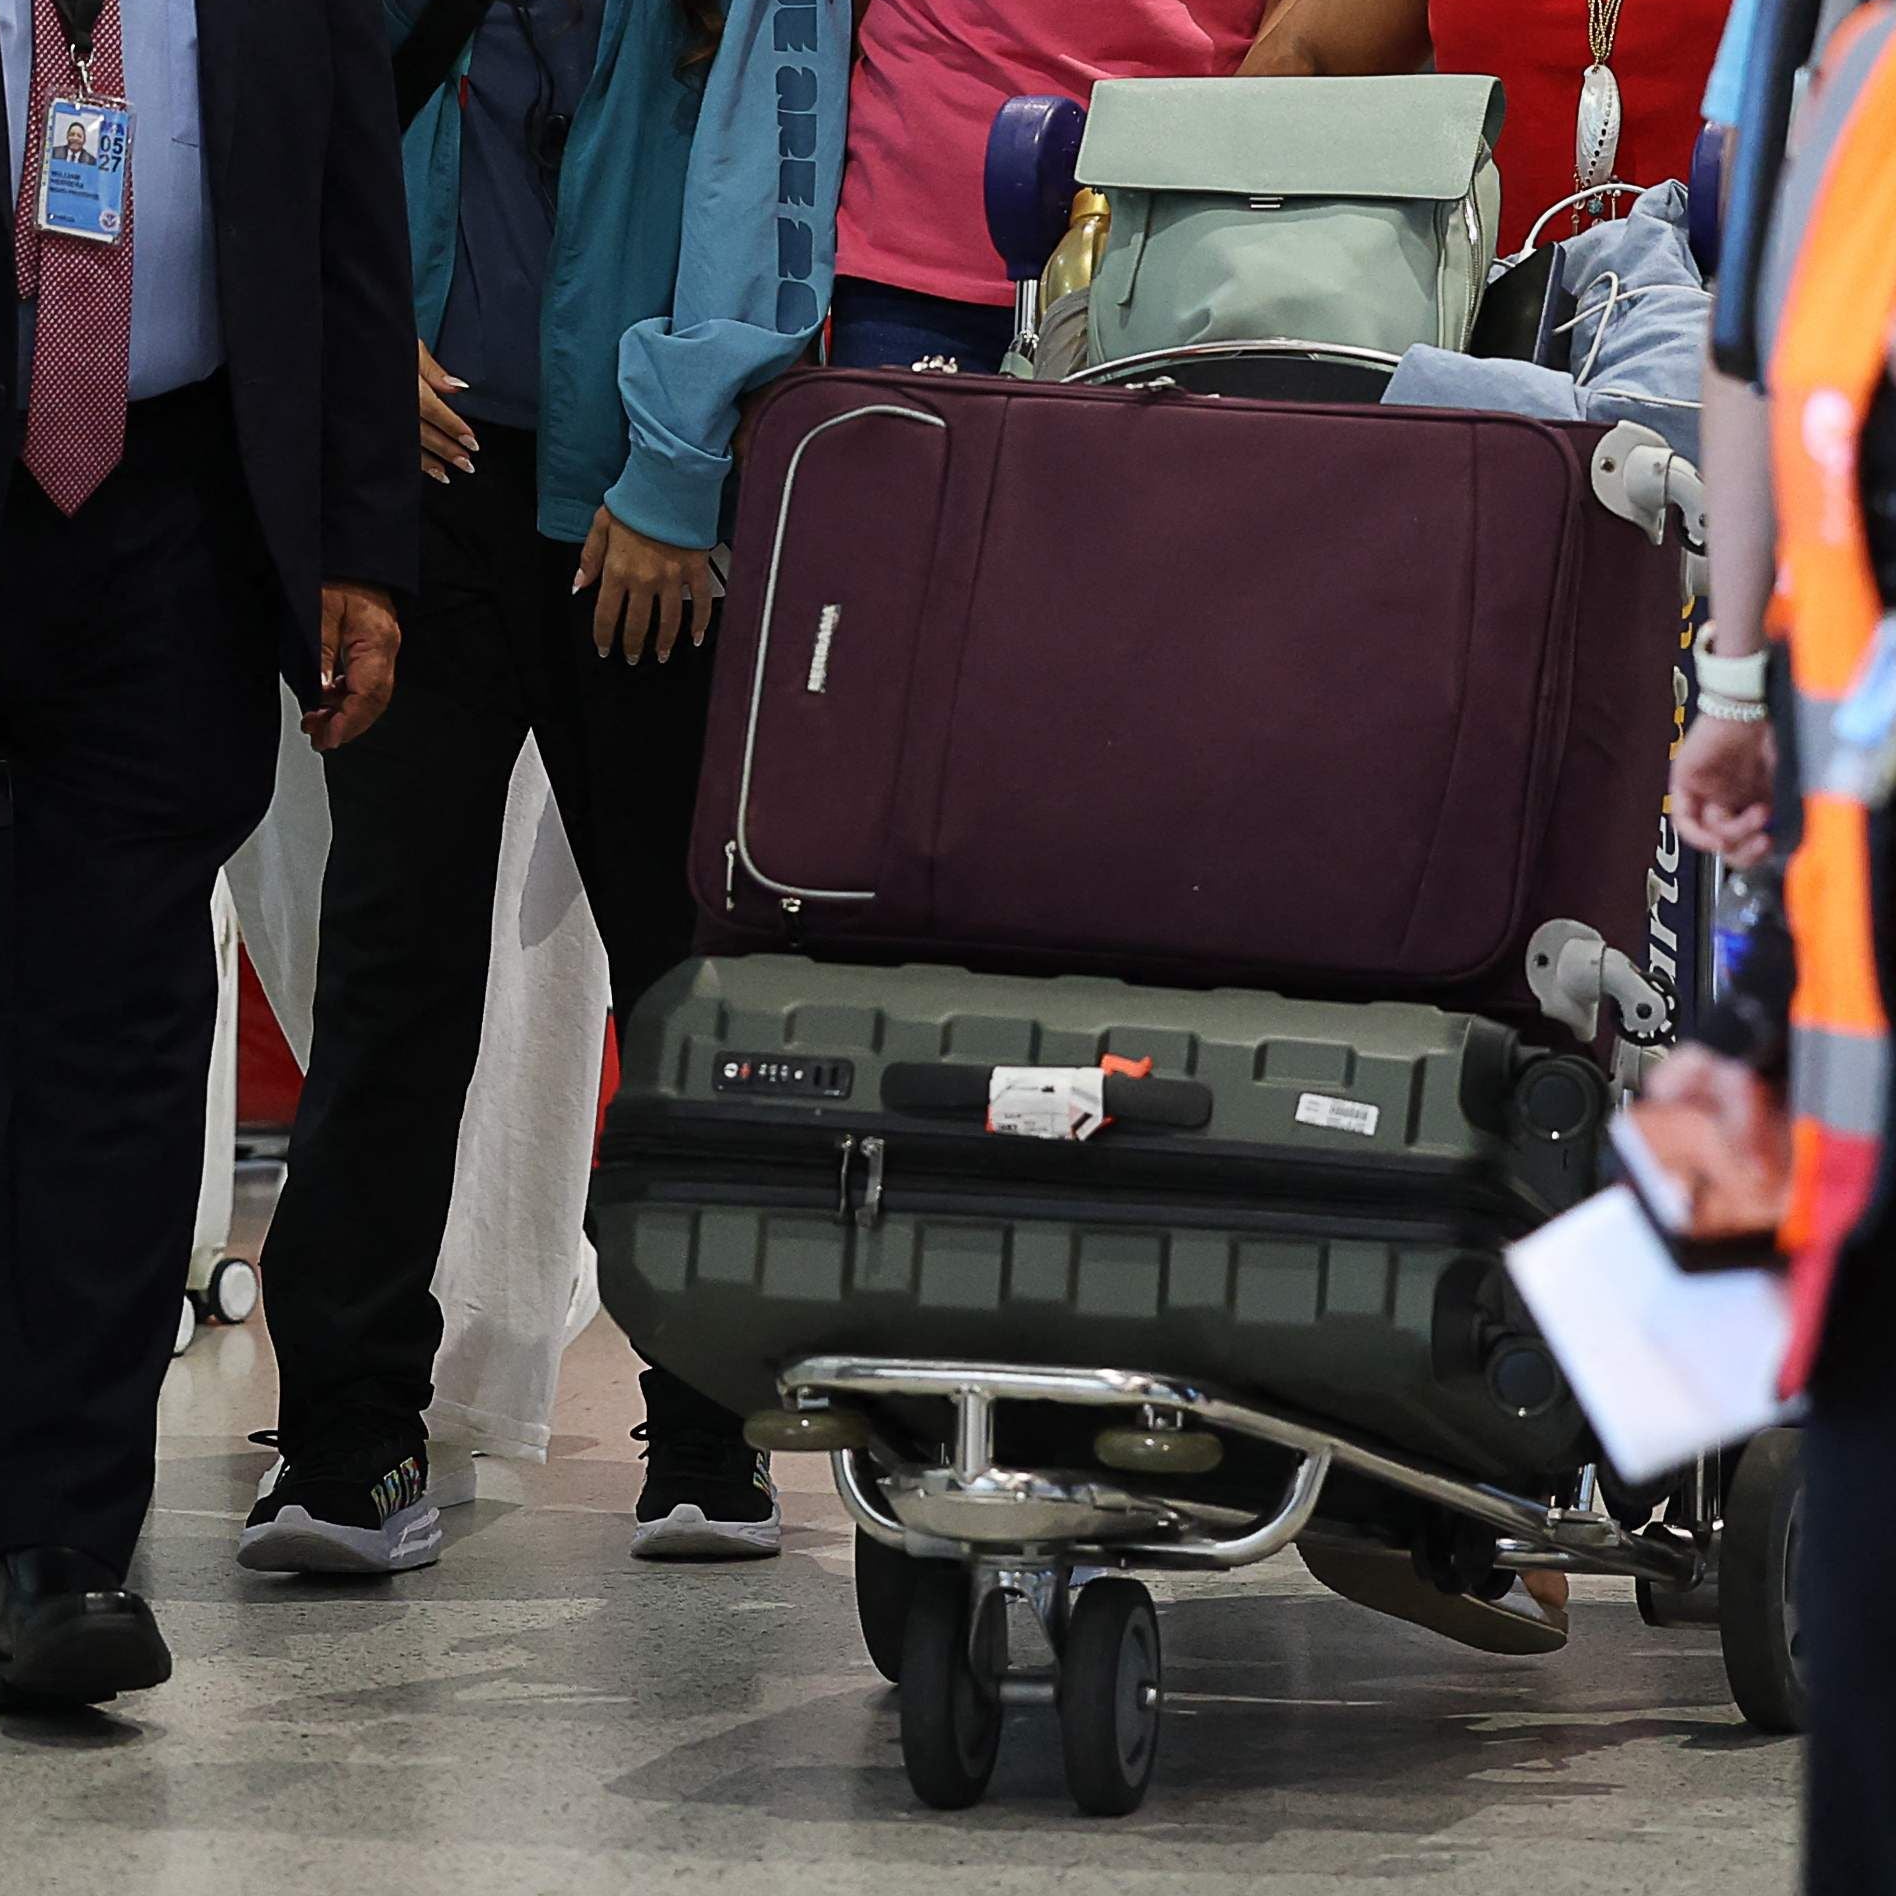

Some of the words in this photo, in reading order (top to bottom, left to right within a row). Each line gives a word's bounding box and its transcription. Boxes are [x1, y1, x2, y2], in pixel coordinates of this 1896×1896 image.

[100, 135, 124, 155] 05
[775, 65, 818, 208] ARE
[98, 155, 122, 173] 27
